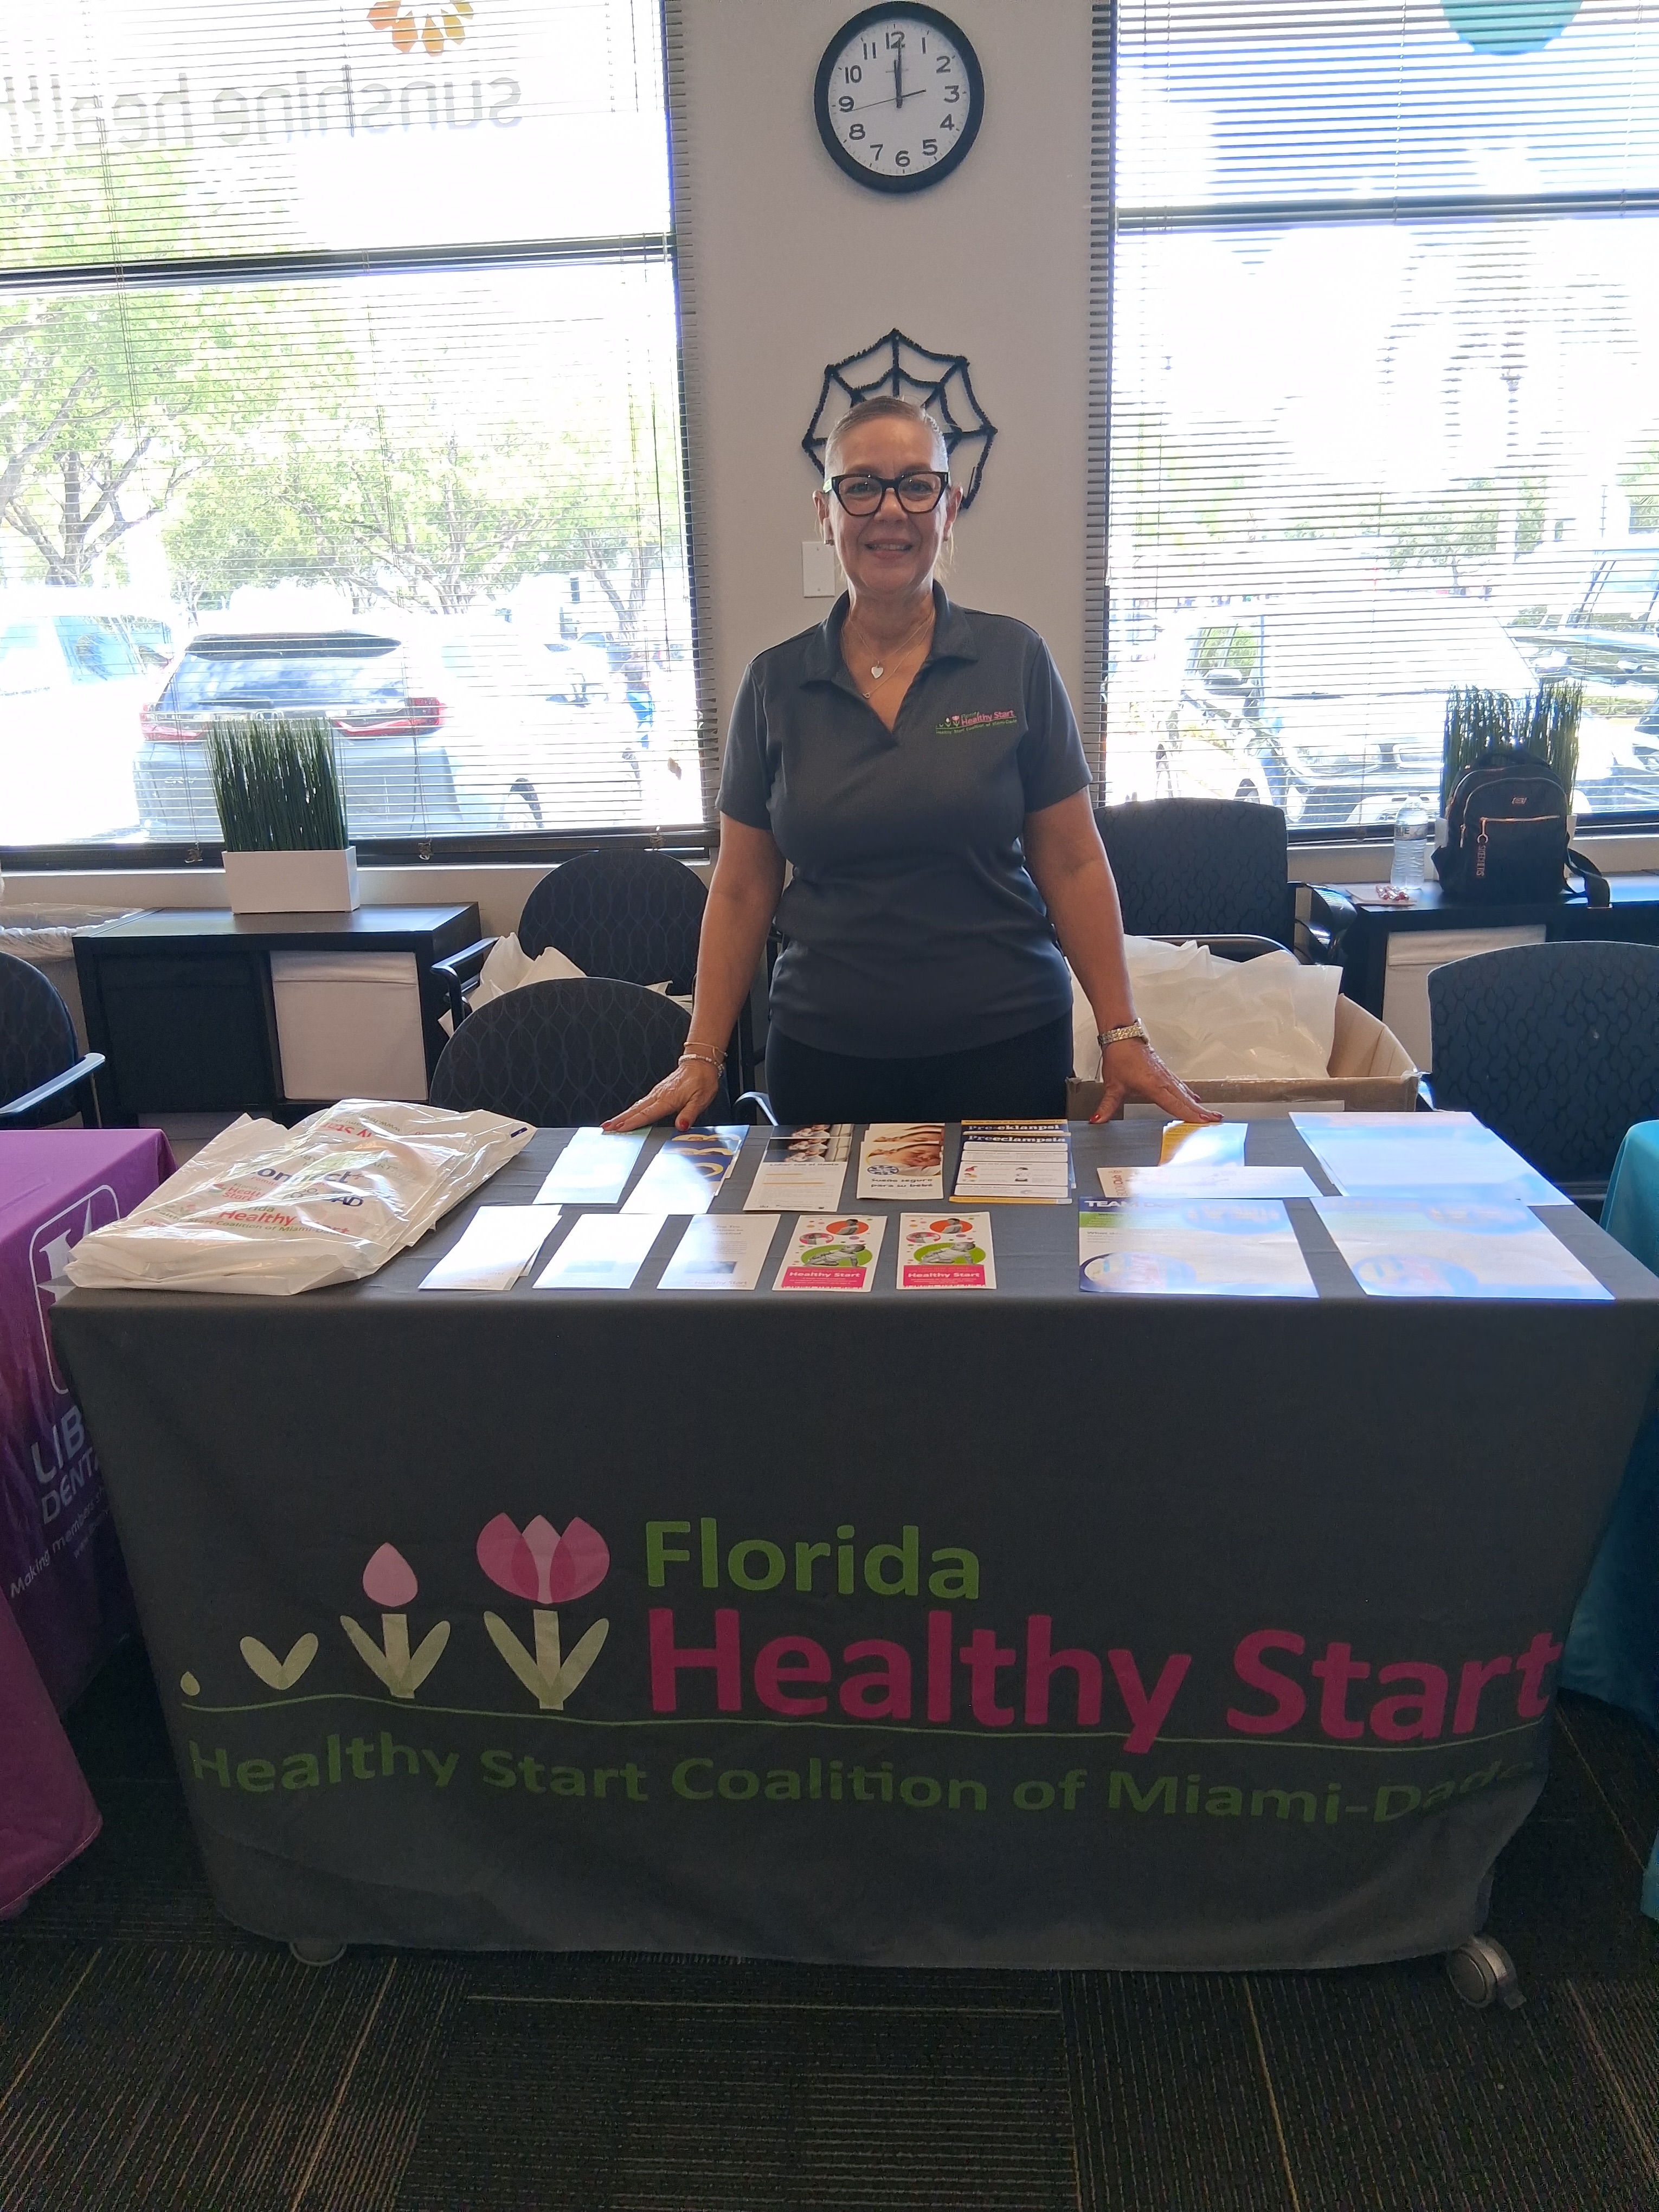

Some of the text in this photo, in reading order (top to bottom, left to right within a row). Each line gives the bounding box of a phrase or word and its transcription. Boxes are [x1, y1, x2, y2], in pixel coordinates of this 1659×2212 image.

[885, 31, 906, 50] 12
[922, 36, 926, 54] 1
[863, 41, 877, 60] 11
[936, 55, 951, 74] 2
[845, 65, 862, 84] 10
[944, 85, 960, 104] 3
[838, 95, 854, 113] 9
[940, 113, 955, 131] 4
[848, 123, 866, 140] 8
[870, 143, 884, 161] 7
[922, 138, 938, 156] 5
[895, 150, 911, 168] 6
[962, 710, 1015, 726] Healthy Start
[216, 1220, 262, 1230] Coalition
[218, 1211, 298, 1226] Healthy
[30, 1405, 85, 1483] LIB
[645, 1517, 980, 1599] Florida
[10, 1549, 51, 1598] Making
[648, 1607, 1564, 1754] Healthy Start
[188, 1731, 460, 1793] Healthy
[480, 1749, 648, 1803] Start
[671, 1758, 988, 1811] Coalition
[1013, 1769, 1088, 1811] of
